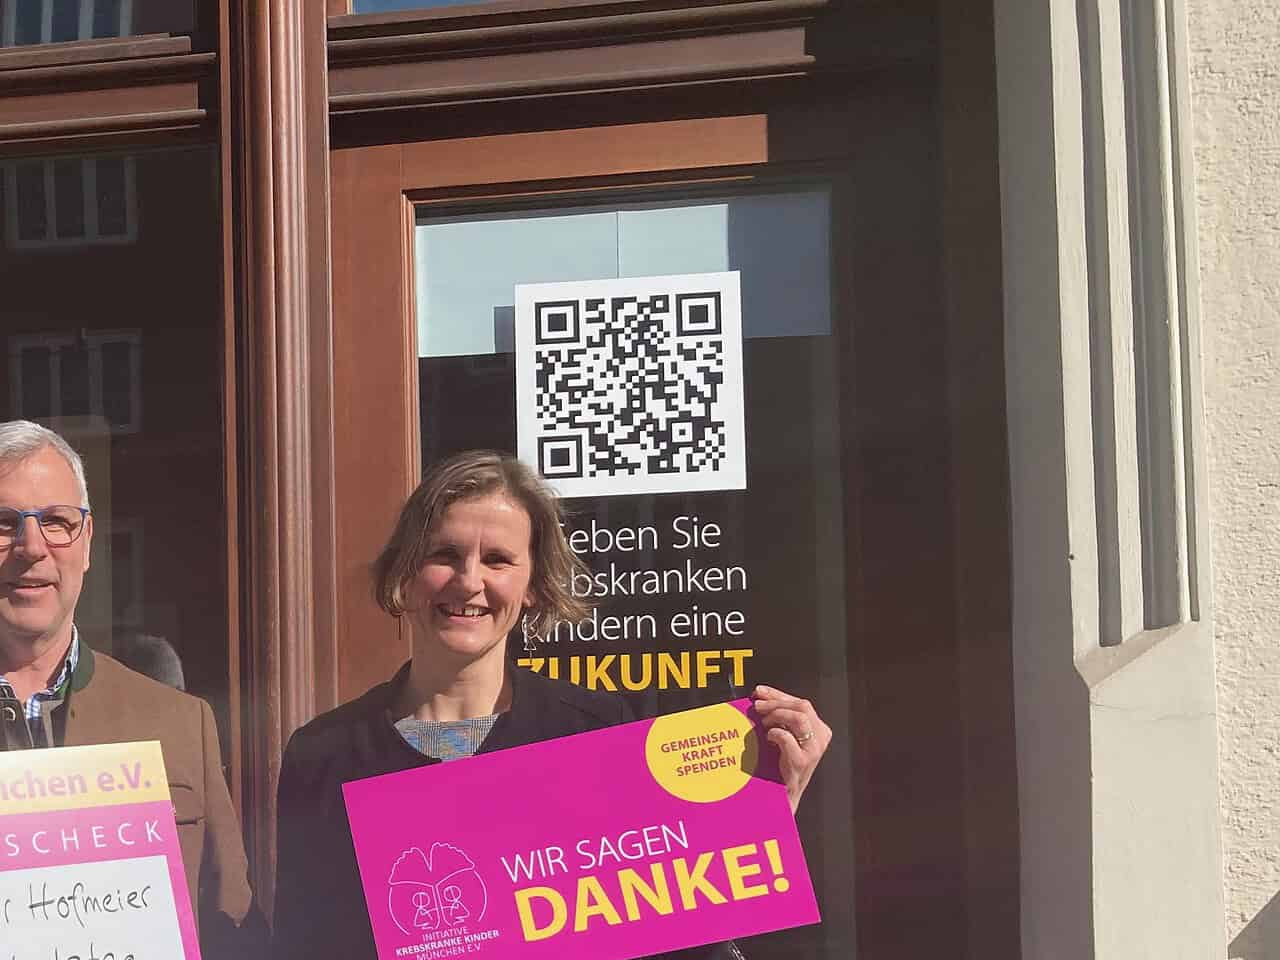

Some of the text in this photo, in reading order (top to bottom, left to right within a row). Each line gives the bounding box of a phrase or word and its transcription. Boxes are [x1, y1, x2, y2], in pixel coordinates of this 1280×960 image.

[558, 516, 721, 554] eben Sie
[560, 559, 747, 598] bskranken
[671, 606, 745, 636] eine
[660, 728, 739, 753] GEMEINSAM
[682, 744, 723, 762] KRAFT
[98, 761, 152, 792] e.V.
[676, 756, 737, 776] SPENDEN
[501, 820, 690, 883] WIR SAGEN
[28, 882, 152, 928] Hofmeier
[513, 838, 790, 942] DANKE!
[395, 929, 500, 957] KREBSKRANKE KINDER
[422, 926, 469, 942] INITIATIVE
